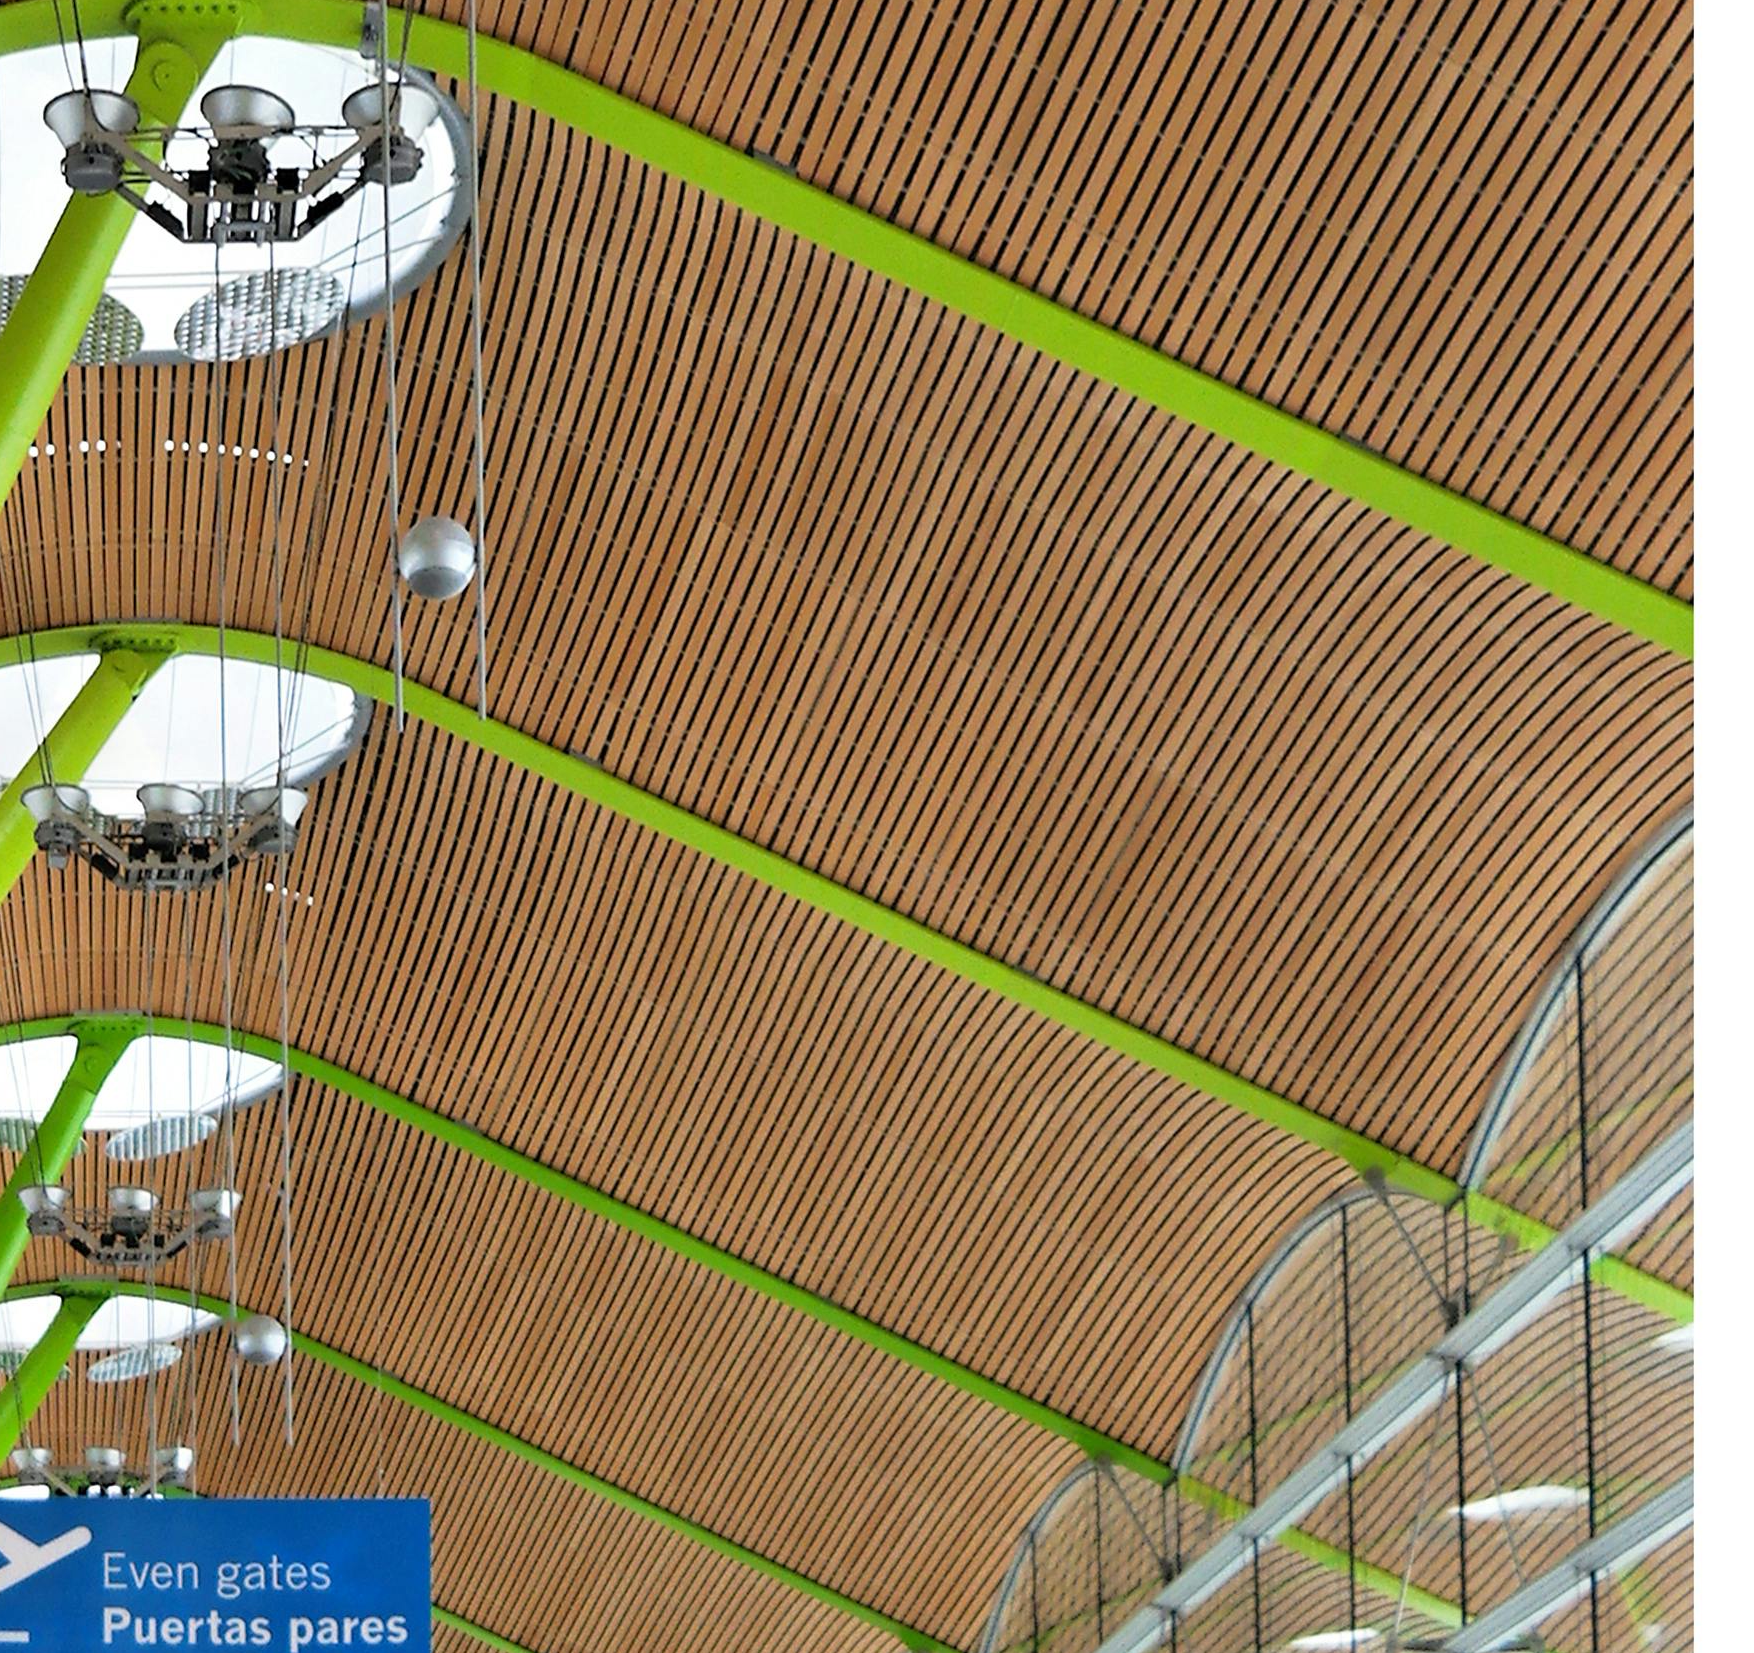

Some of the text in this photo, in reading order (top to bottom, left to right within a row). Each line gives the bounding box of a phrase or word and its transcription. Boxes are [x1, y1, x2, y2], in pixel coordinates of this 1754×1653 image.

[103, 1552, 331, 1599] Even gates
[103, 1607, 408, 1653] Puertas pares
